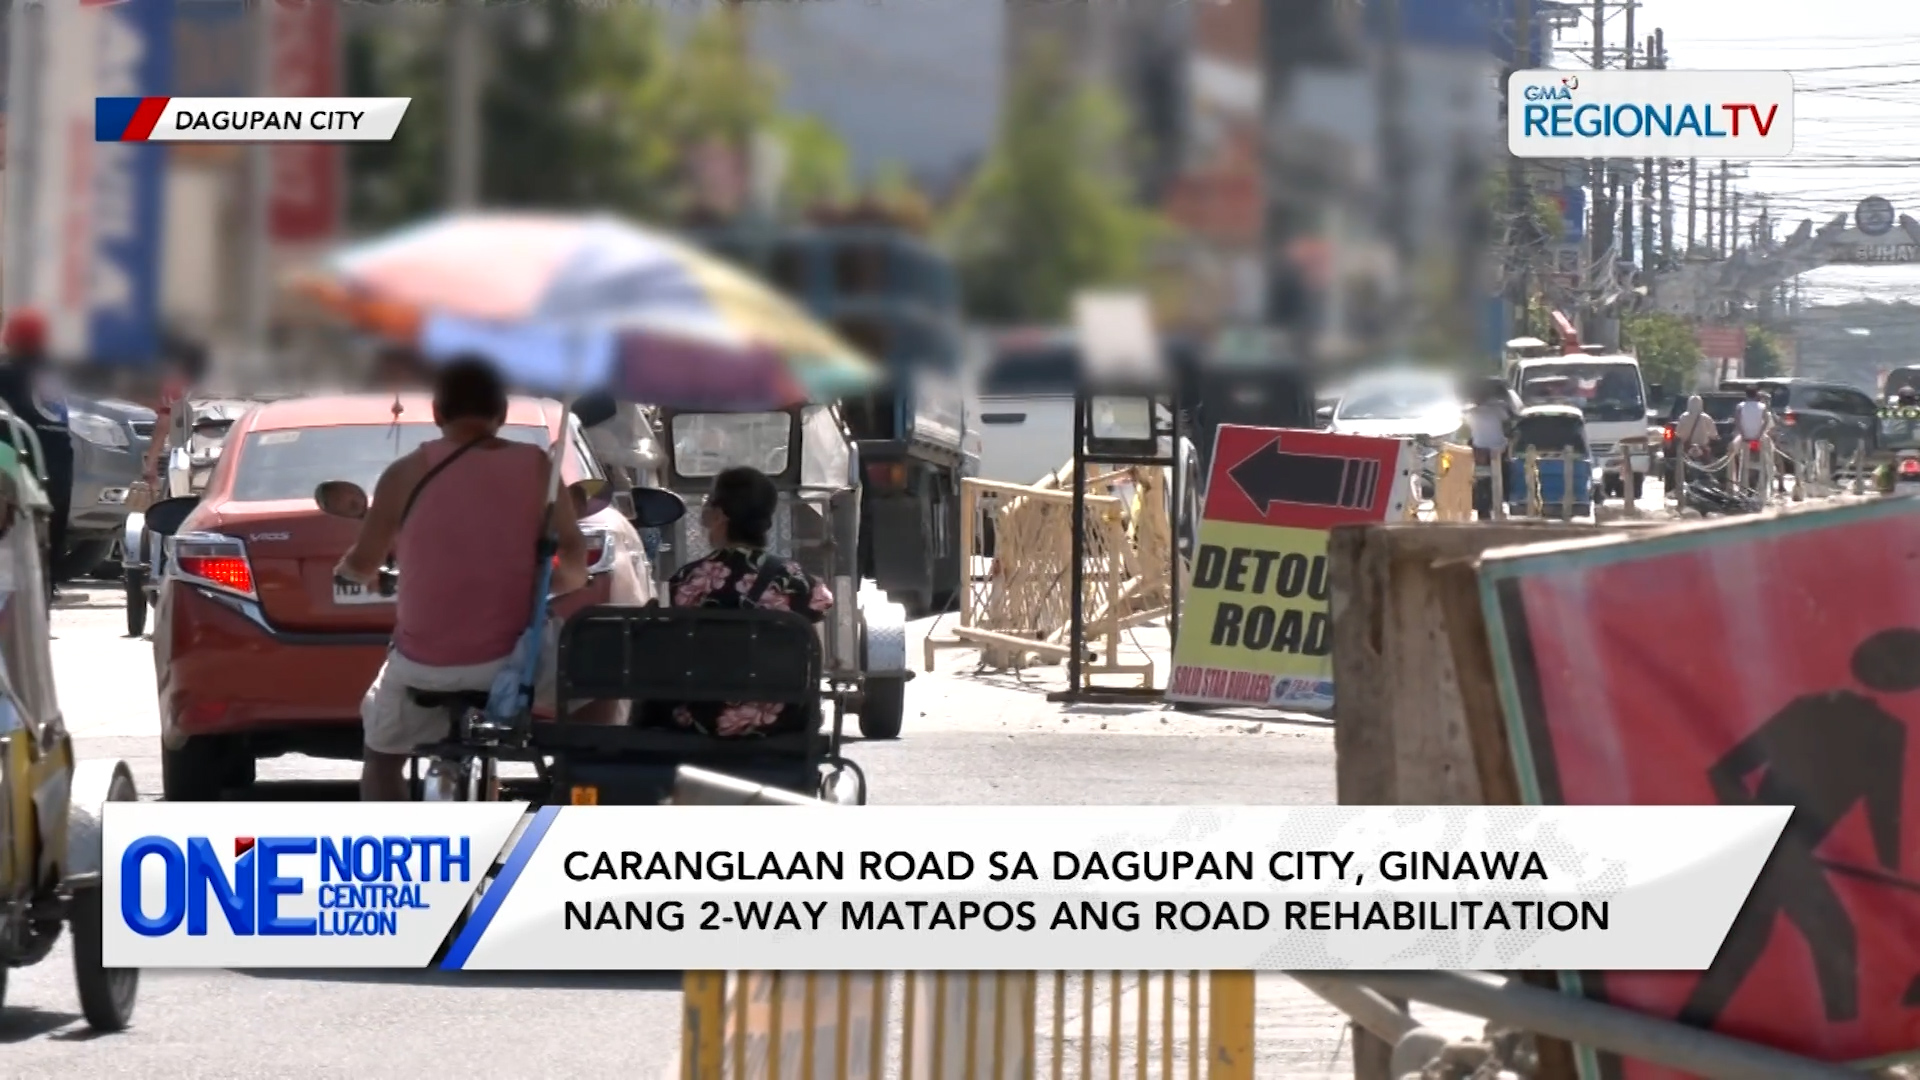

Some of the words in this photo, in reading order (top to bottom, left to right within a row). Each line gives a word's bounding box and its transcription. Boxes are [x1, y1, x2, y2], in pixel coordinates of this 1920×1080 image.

[1192, 545, 1329, 600] DETOU
[1210, 602, 1331, 657] ROAD
[1172, 665, 1203, 696] SOLID
[1201, 667, 1228, 699] STAR
